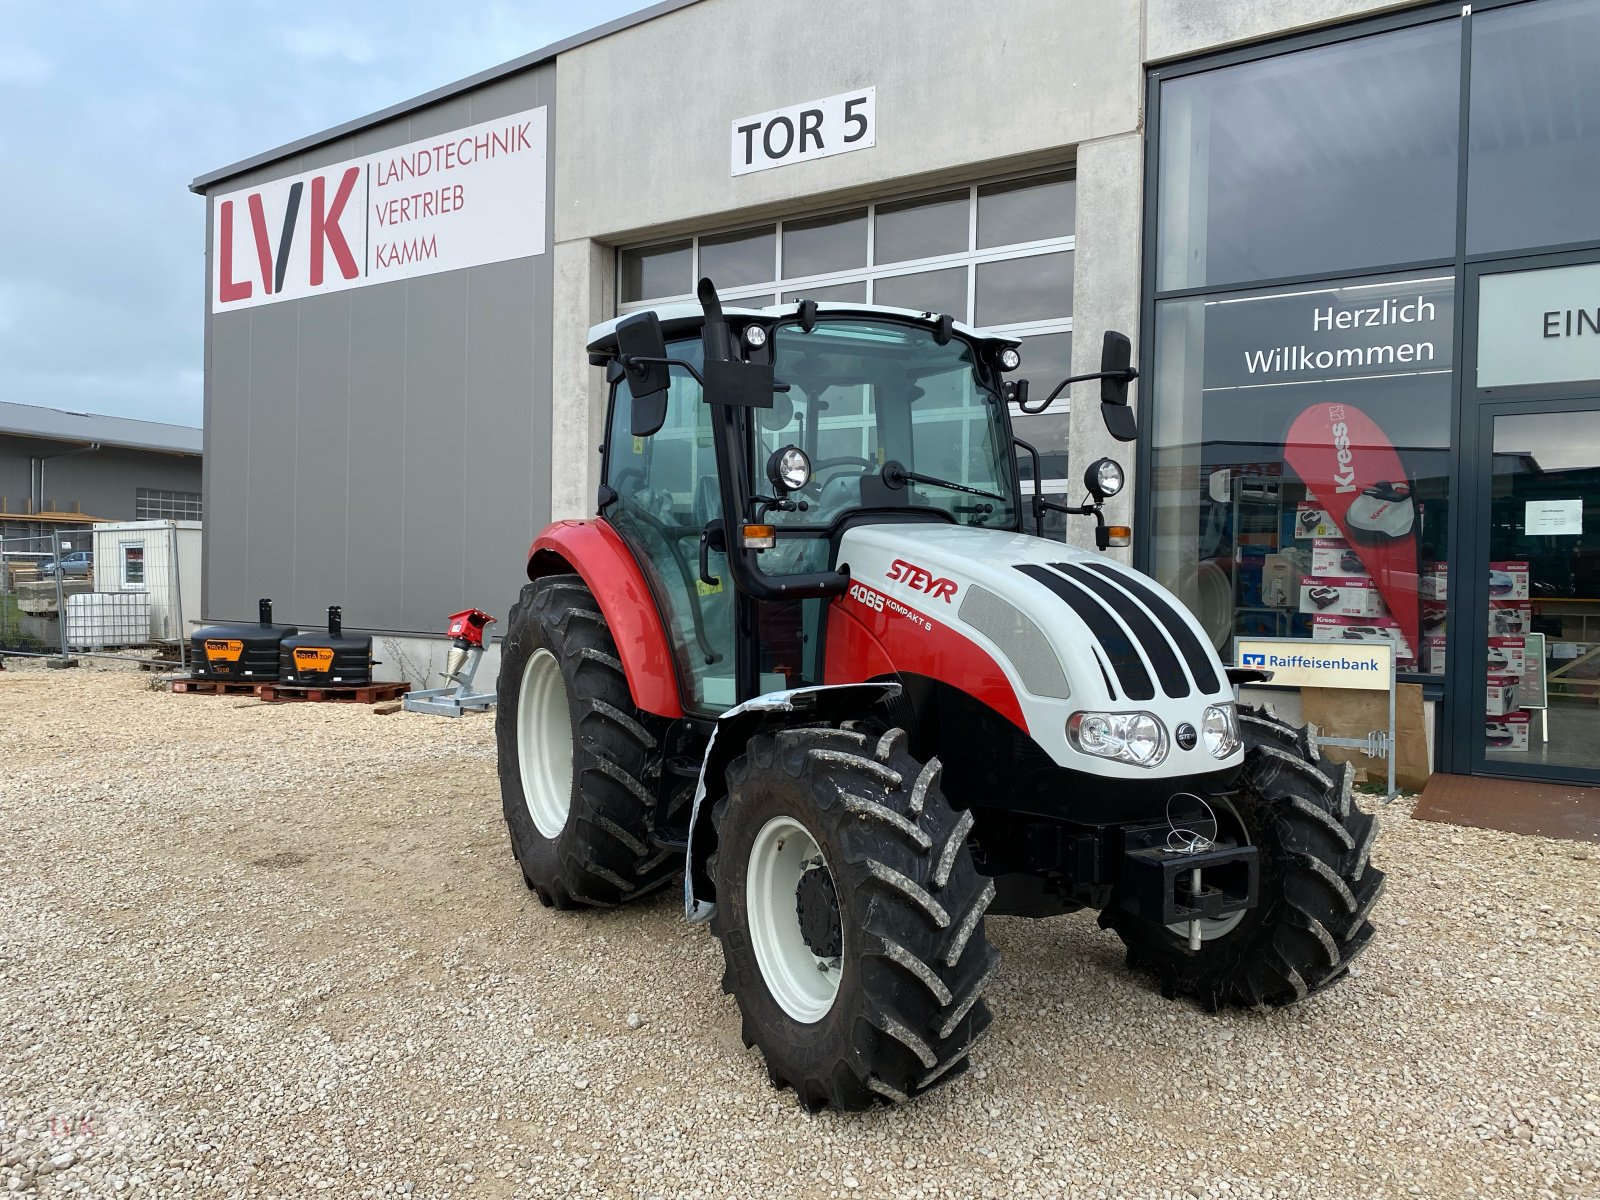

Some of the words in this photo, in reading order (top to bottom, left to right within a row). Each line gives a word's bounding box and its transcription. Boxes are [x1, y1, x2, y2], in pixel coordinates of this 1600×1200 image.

[738, 109, 825, 165] TOR
[844, 96, 868, 143] 5
[377, 122, 532, 187] LANDTECHNIK
[375, 184, 464, 227] VERTRIEB
[219, 166, 361, 303] LVK
[376, 234, 437, 270] KAMM
[1313, 295, 1435, 332] Herzlich
[1543, 307, 1600, 338] EIN
[1244, 340, 1434, 374] Willkommen
[1332, 422, 1357, 494] Kress
[886, 559, 958, 604] STEYR
[850, 584, 885, 613] 4065
[885, 599, 924, 626] KOMPAKT
[924, 622, 932, 631] S
[1316, 616, 1337, 624] Kress
[1269, 655, 1379, 672] Raiffeisenbank
